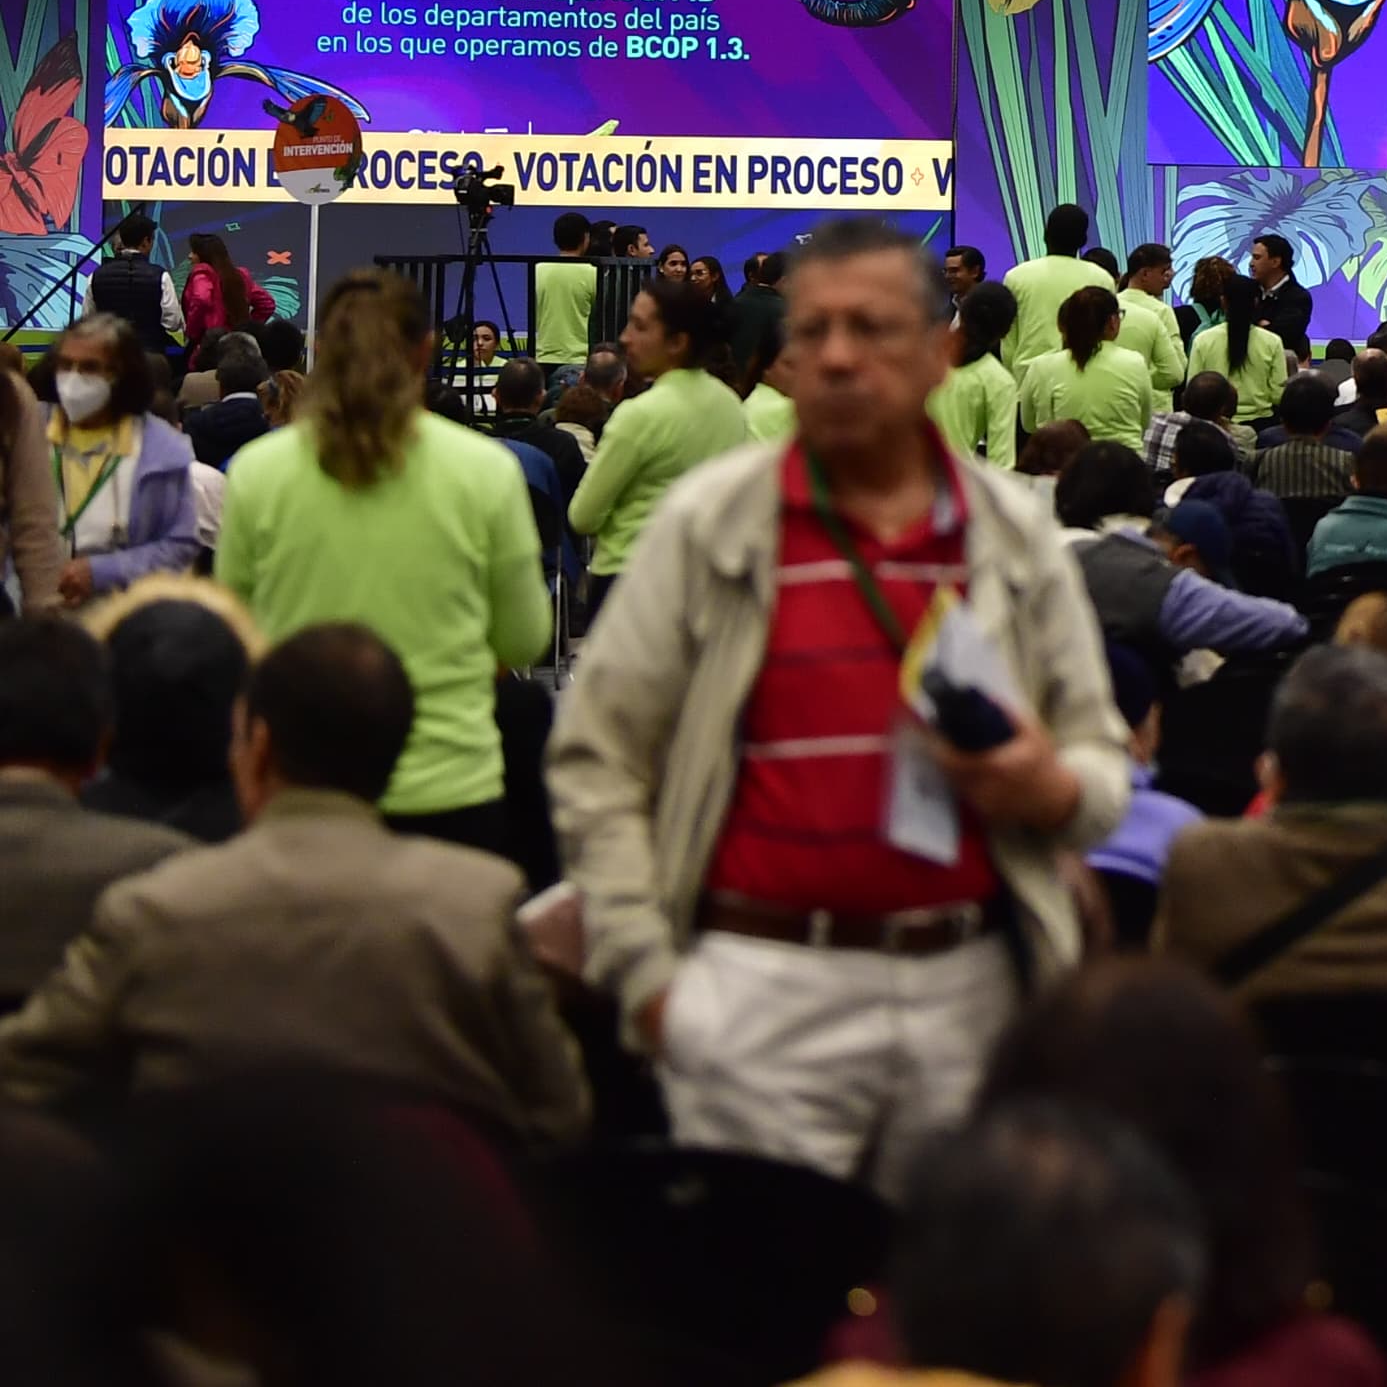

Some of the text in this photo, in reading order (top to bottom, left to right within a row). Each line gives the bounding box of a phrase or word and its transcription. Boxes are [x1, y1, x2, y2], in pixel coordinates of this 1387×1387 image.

[342, 1, 720, 36] de los departamentos del país
[317, 30, 750, 61] en los que operamos de BCOP 1.3.
[104, 133, 257, 188] OTACIÓN
[283, 140, 354, 157] INTERVENCIÓN
[513, 140, 904, 196] VOTACIÓN EN PROCESO
